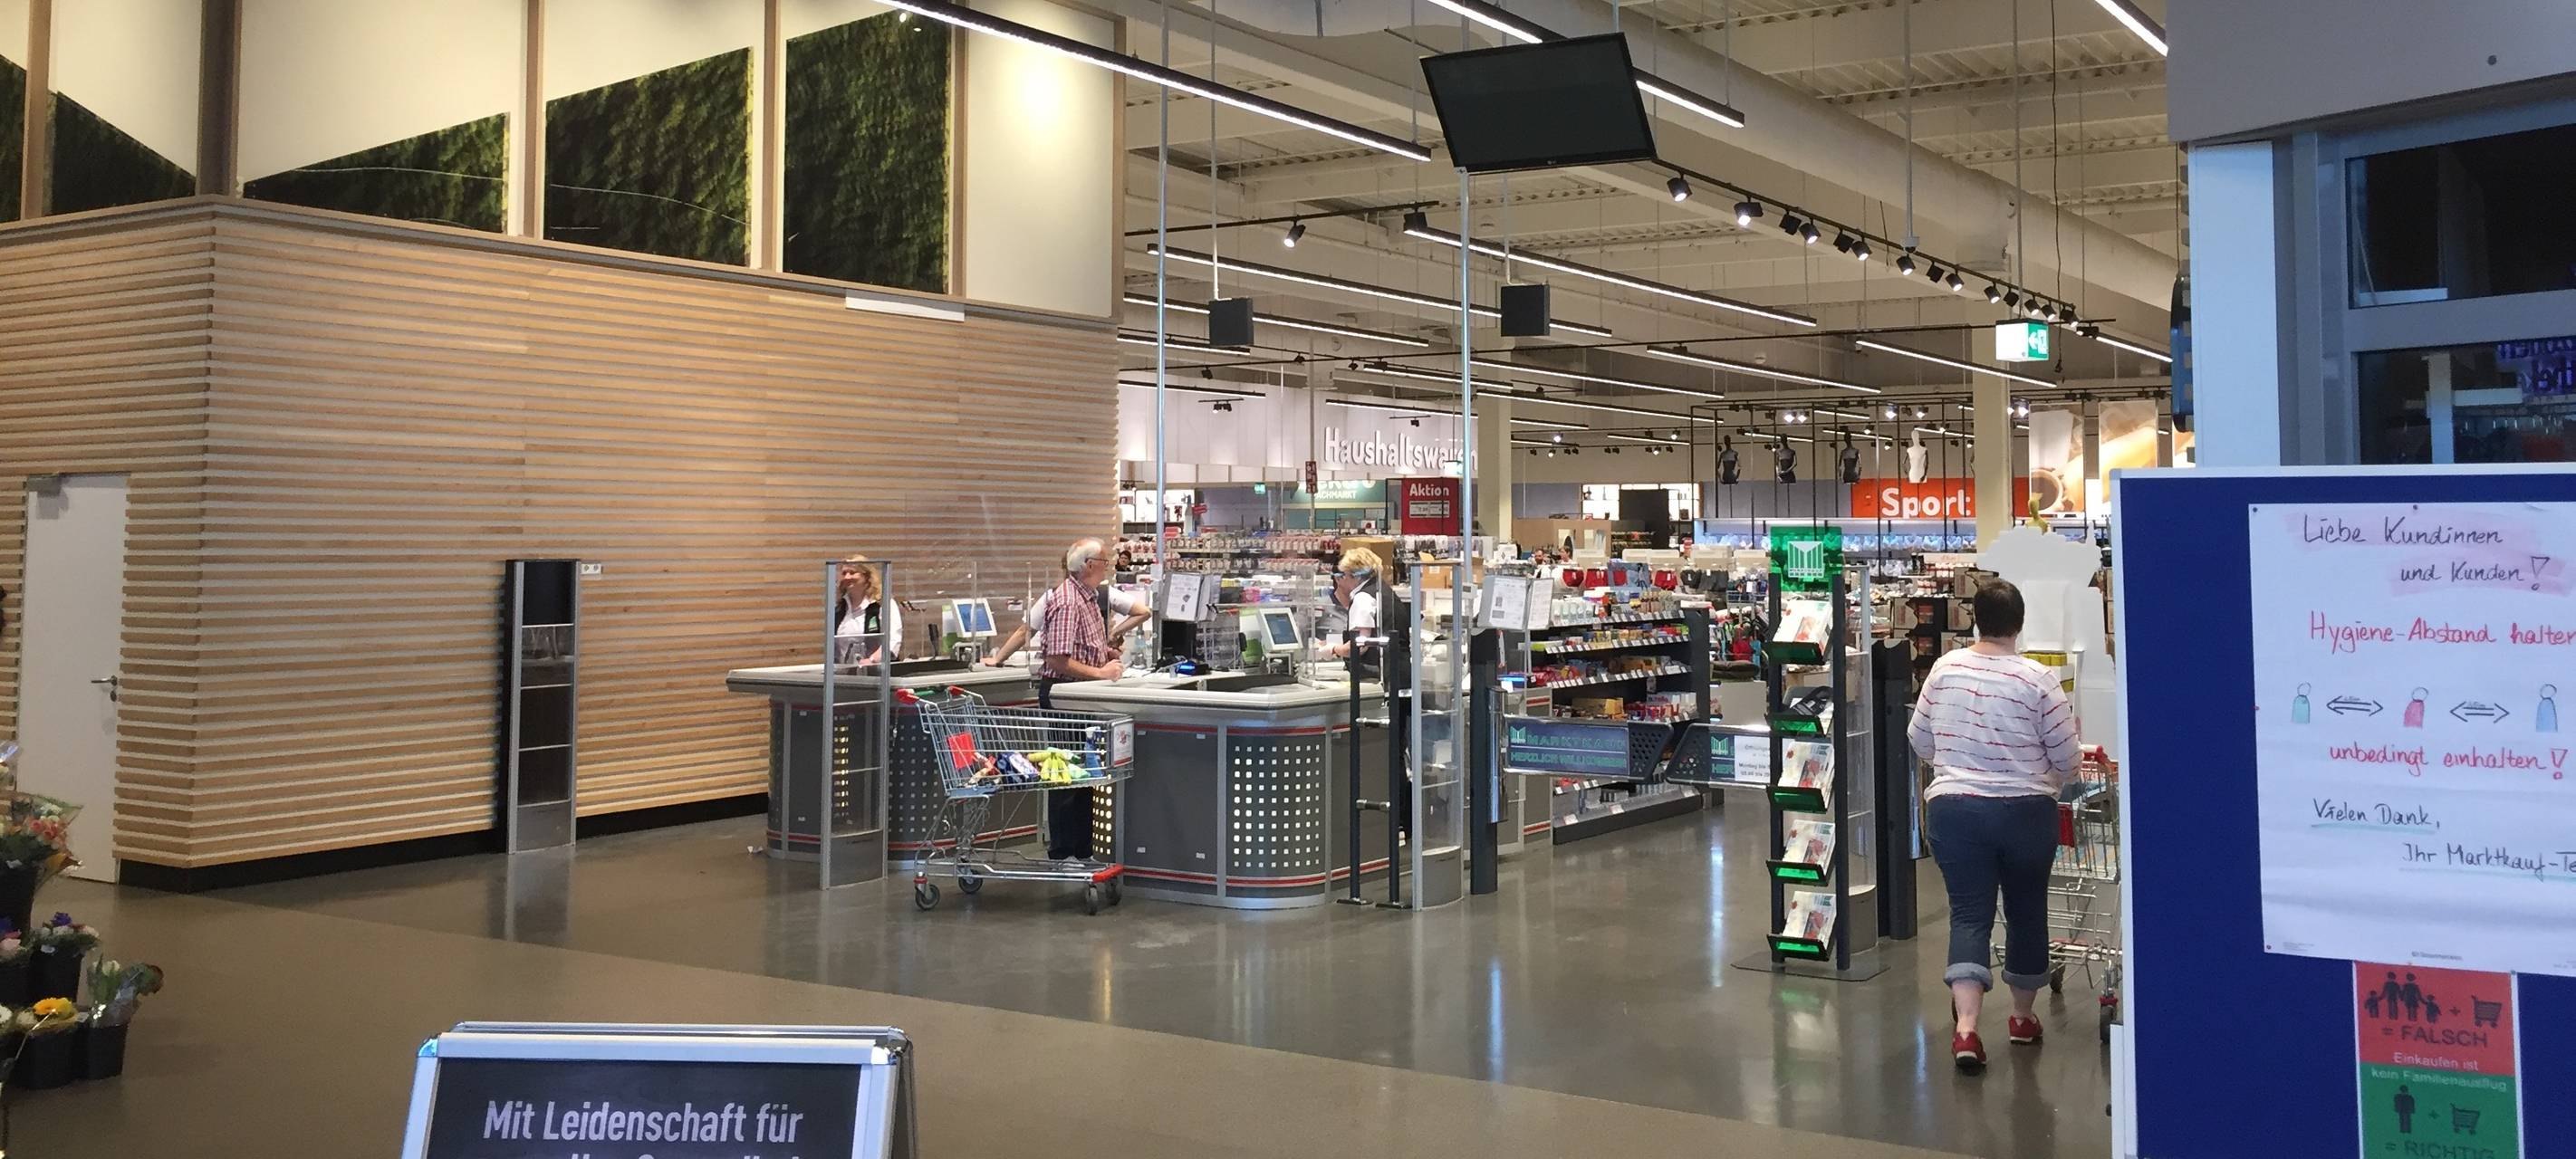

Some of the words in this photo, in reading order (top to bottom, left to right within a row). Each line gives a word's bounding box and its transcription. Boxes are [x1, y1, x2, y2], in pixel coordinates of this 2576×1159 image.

[1314, 490, 1357, 500] ACHMARKT
[1409, 483, 1449, 496] Aktion
[1881, 487, 1972, 517] Sport
[2303, 514, 2366, 542] Liebe
[2384, 516, 2504, 544] Kundinnen
[2400, 563, 2442, 582] und
[2311, 610, 2497, 653] Hygiene-Abstand
[2331, 742, 2428, 777] unbedingt
[2313, 798, 2368, 821] Vielen
[2402, 843, 2437, 862] Ihr
[2401, 1026, 2488, 1048] FALSCH
[2393, 1052, 2458, 1070] Einkaufen
[2463, 1058, 2479, 1071] ist
[2371, 1068, 2398, 1081] kein
[2403, 1070, 2507, 1092] Familienausflug
[483, 1101, 534, 1139] Mit
[543, 1101, 745, 1143] Leidenschaft
[757, 1103, 803, 1143] für
